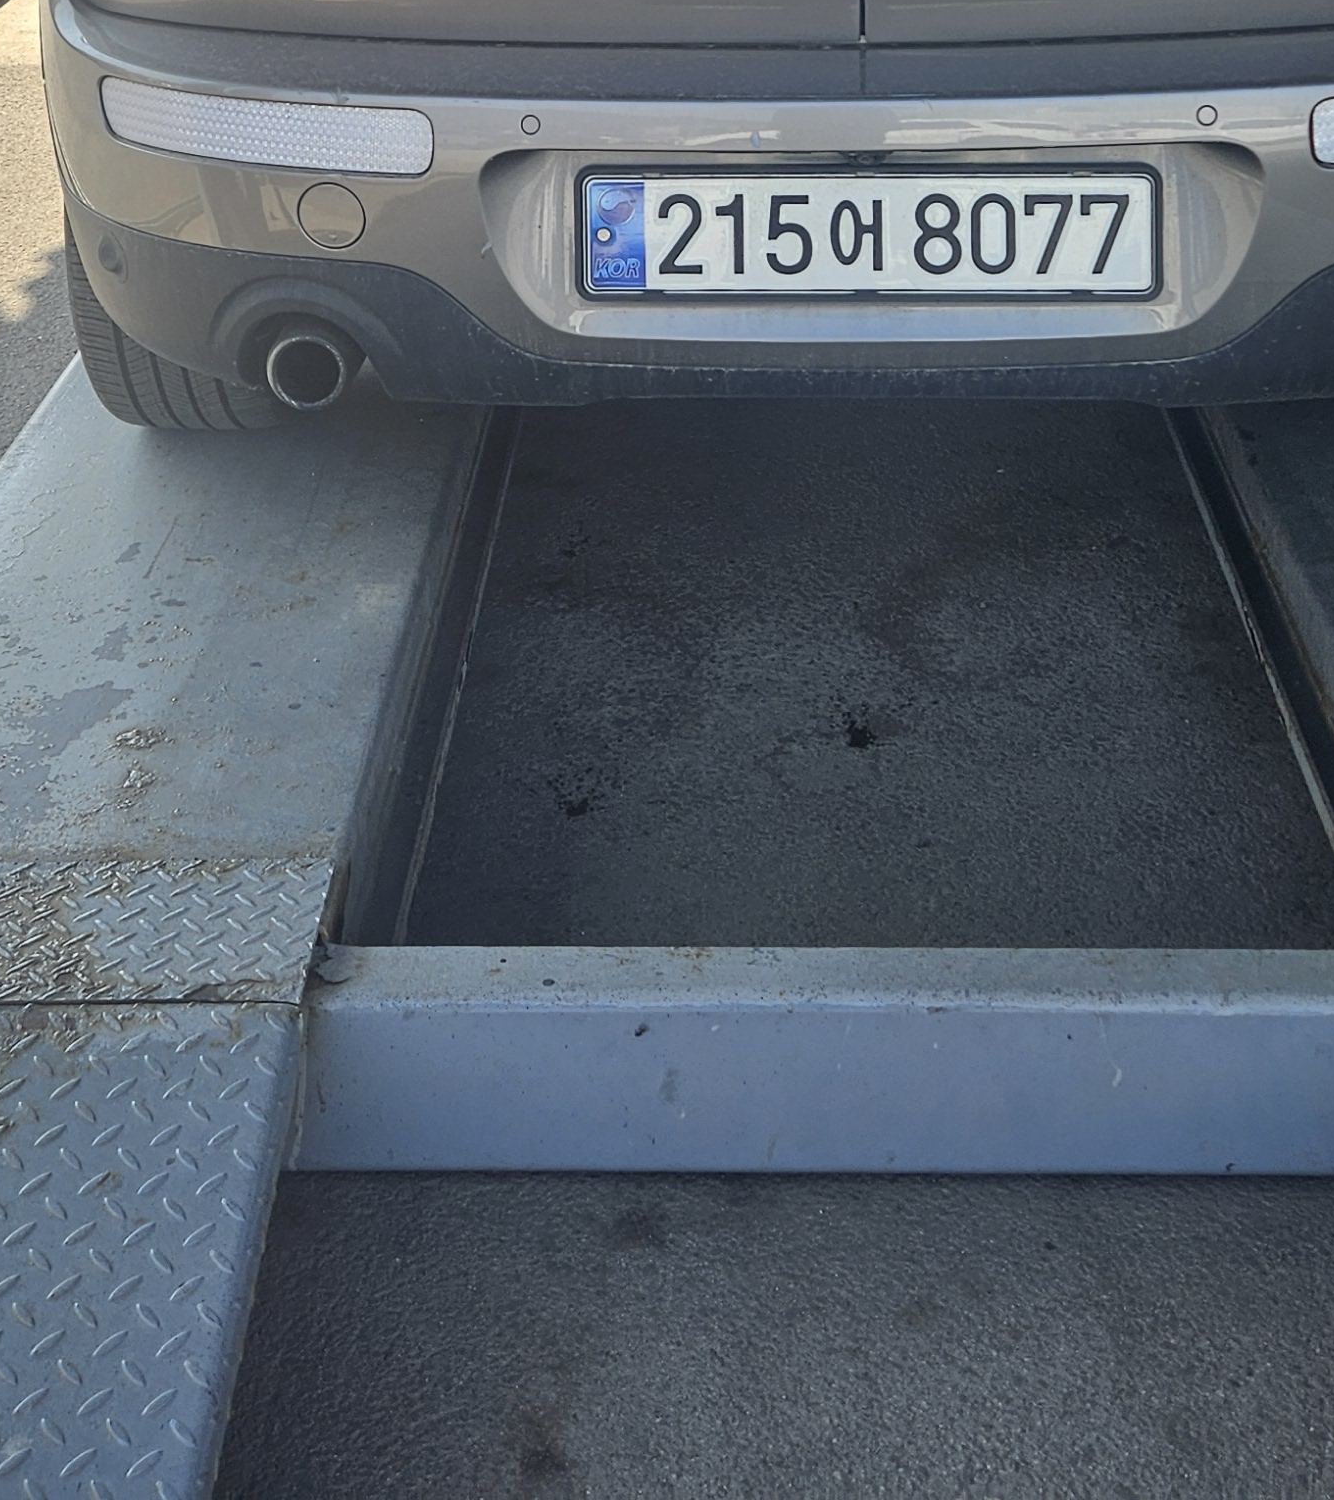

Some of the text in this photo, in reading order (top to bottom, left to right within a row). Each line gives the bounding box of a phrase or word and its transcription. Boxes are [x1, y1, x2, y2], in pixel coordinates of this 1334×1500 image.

[657, 194, 1130, 275] 215어 8077
[592, 258, 640, 279] KOR
